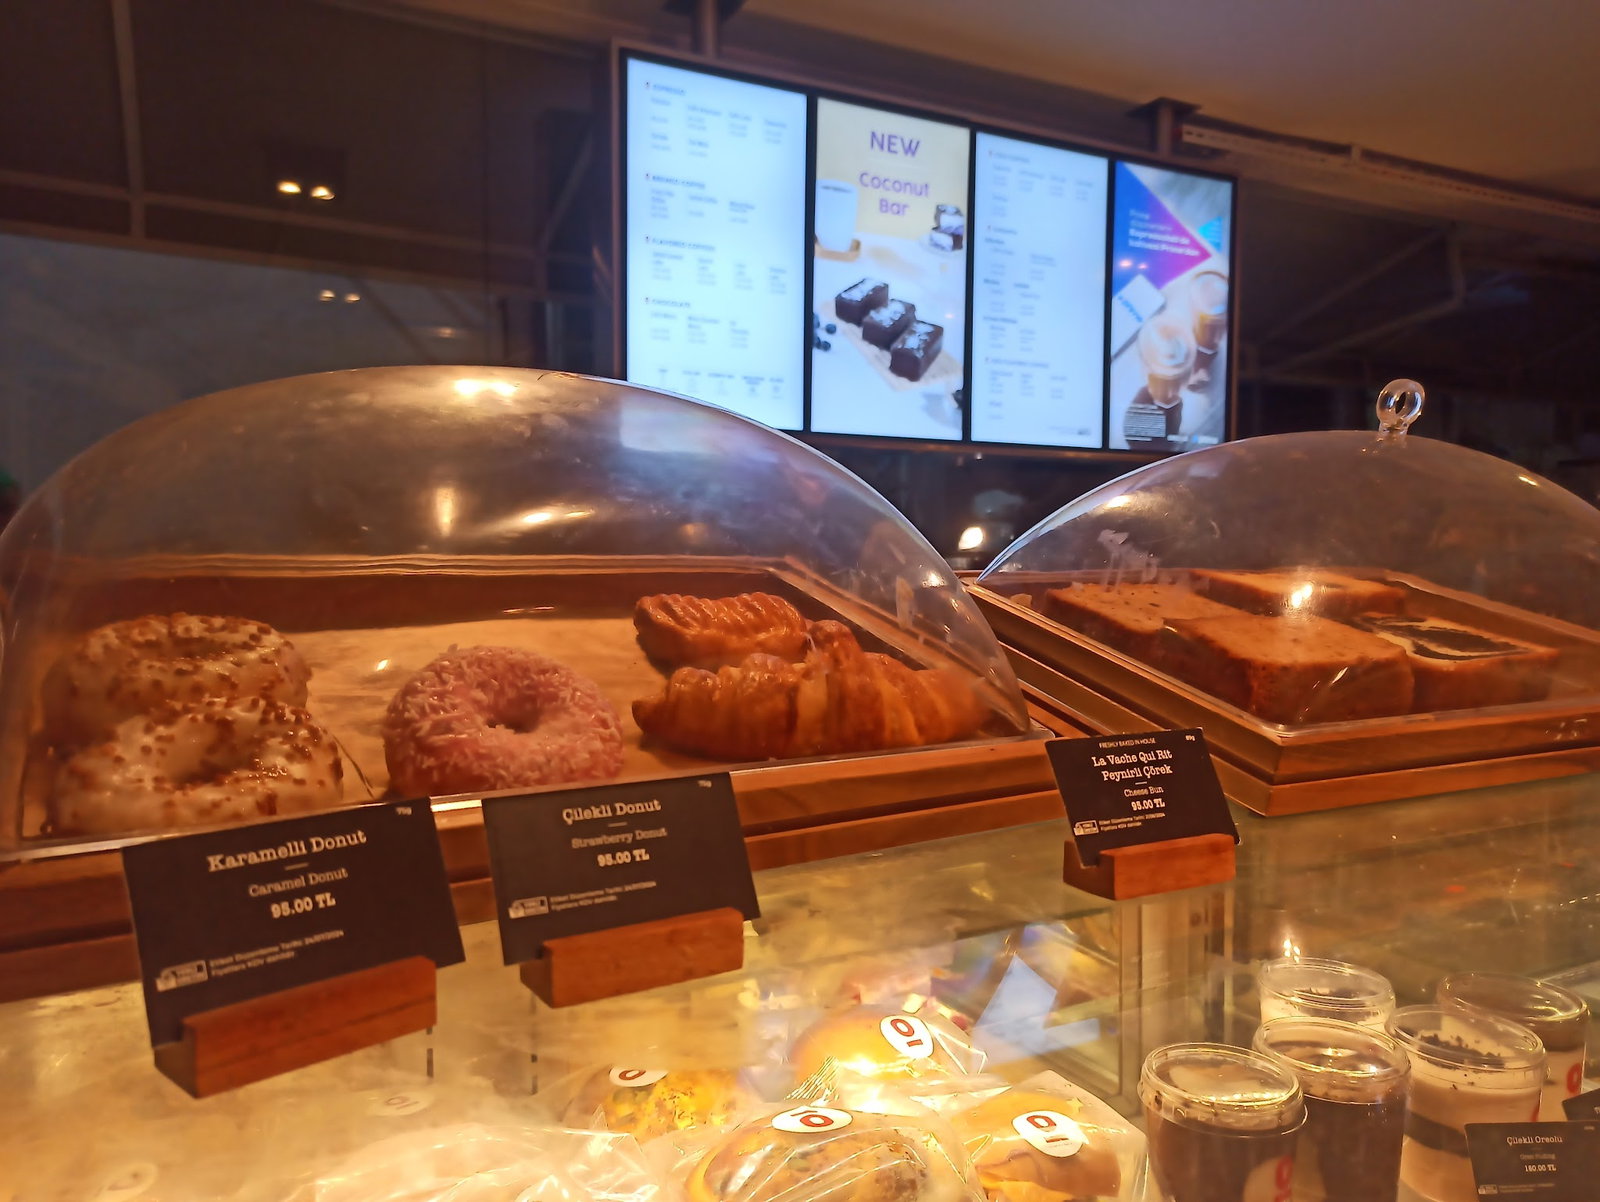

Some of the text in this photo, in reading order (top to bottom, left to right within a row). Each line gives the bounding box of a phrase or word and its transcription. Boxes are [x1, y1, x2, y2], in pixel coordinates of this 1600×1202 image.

[870, 131, 921, 157] NEW
[859, 172, 930, 197] Coconut
[879, 198, 910, 216] Bar
[1091, 749, 1173, 767] La Vache Qui Rit
[1101, 764, 1173, 782] Peynirli Çörek
[1124, 786, 1164, 797] Cheese Bun
[562, 798, 662, 826] Çilekli Donut
[1131, 798, 1166, 811] 95.00 TL
[571, 827, 668, 849] Strawberry Donut
[207, 829, 368, 872] Karamelli Donut
[597, 848, 650, 867] 95.00 TL
[248, 867, 348, 899] Caramel Donut
[270, 893, 337, 919] 95.00 TL
[1506, 1135, 1563, 1146] Çilekli Oreolu
[1547, 1163, 1557, 1171] TL
